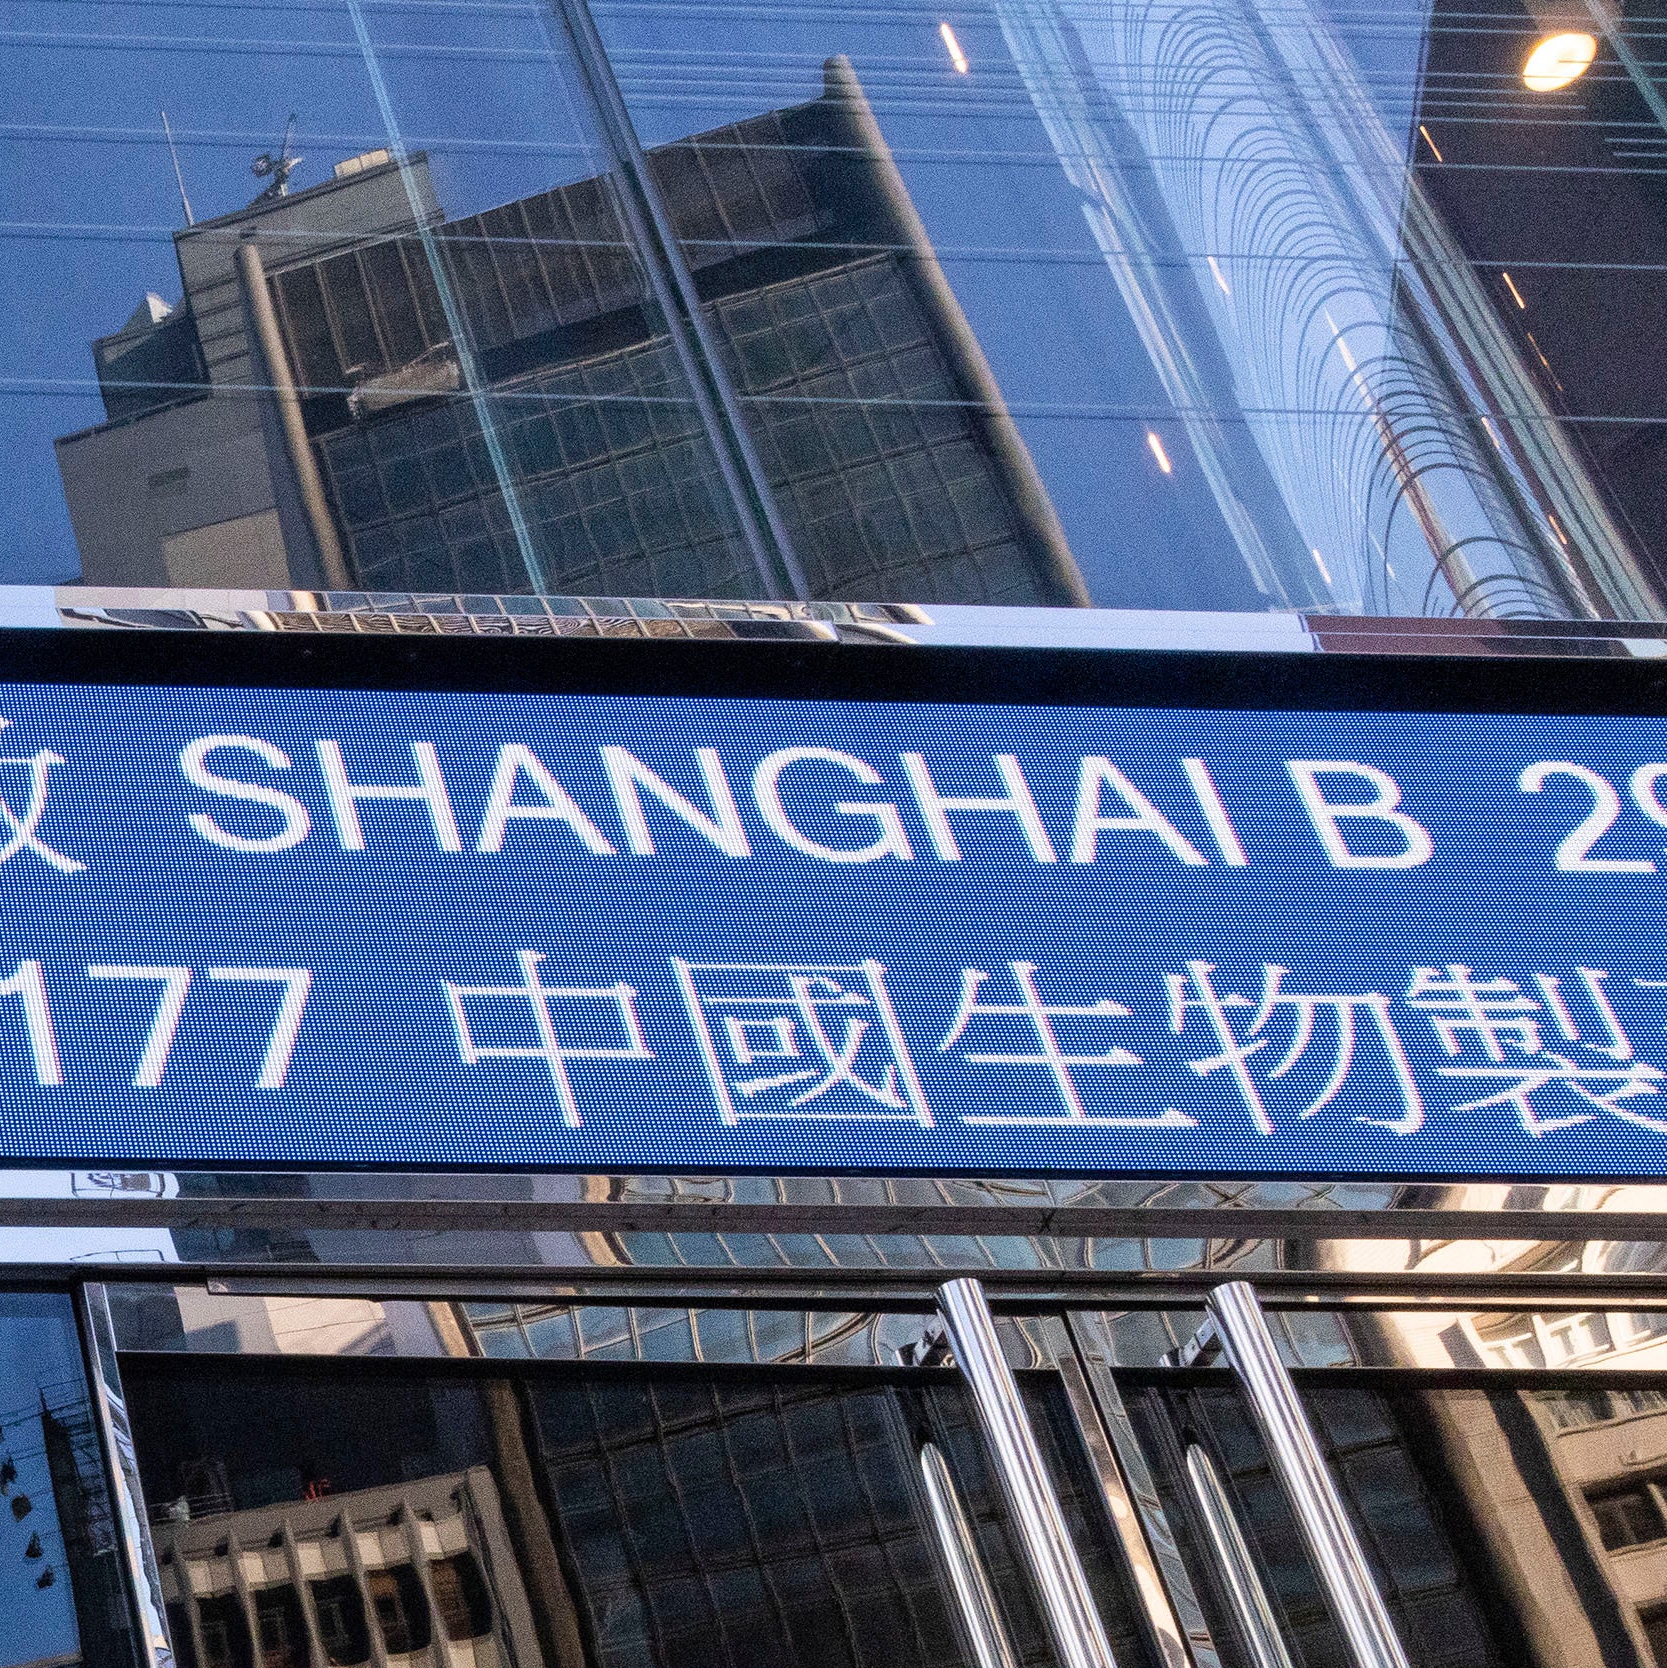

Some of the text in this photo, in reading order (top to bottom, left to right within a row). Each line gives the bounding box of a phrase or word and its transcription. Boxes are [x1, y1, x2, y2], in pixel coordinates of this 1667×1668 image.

[179, 734, 1248, 867] SHANGHAI
[1289, 759, 1433, 870] B
[442, 949, 1667, 1137] 中國生物製
